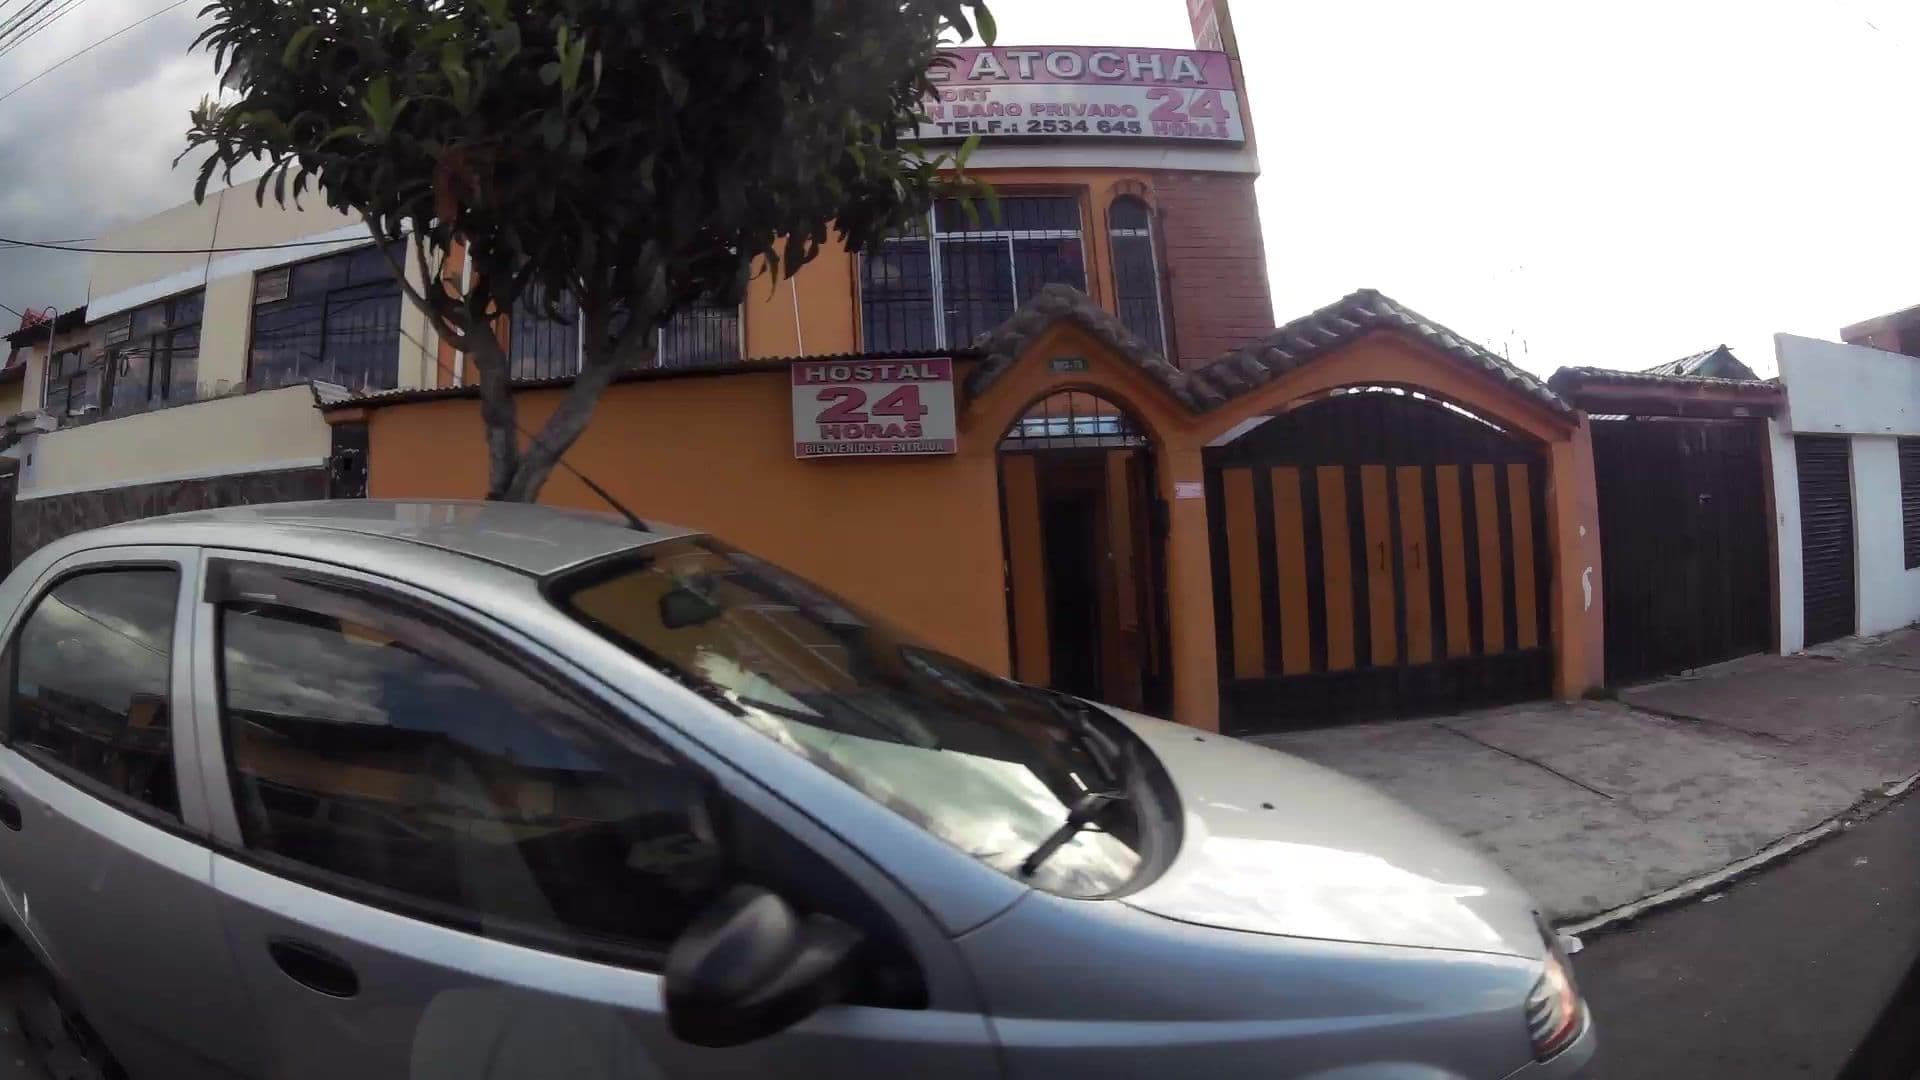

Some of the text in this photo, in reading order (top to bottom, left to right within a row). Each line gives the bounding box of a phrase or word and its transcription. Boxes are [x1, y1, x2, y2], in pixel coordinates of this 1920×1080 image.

[968, 51, 1207, 84] ATOCHA
[1030, 103, 1138, 118] PRIVADO
[1146, 87, 1230, 123] 24
[1026, 119, 1088, 134] 2534
[1096, 120, 1142, 134] 645
[1152, 121, 1229, 138] HORAS
[805, 363, 939, 382] HOSTAL
[816, 384, 928, 424] 24
[819, 422, 923, 440] HORAS
[805, 441, 881, 455] BIENVENIDOS
